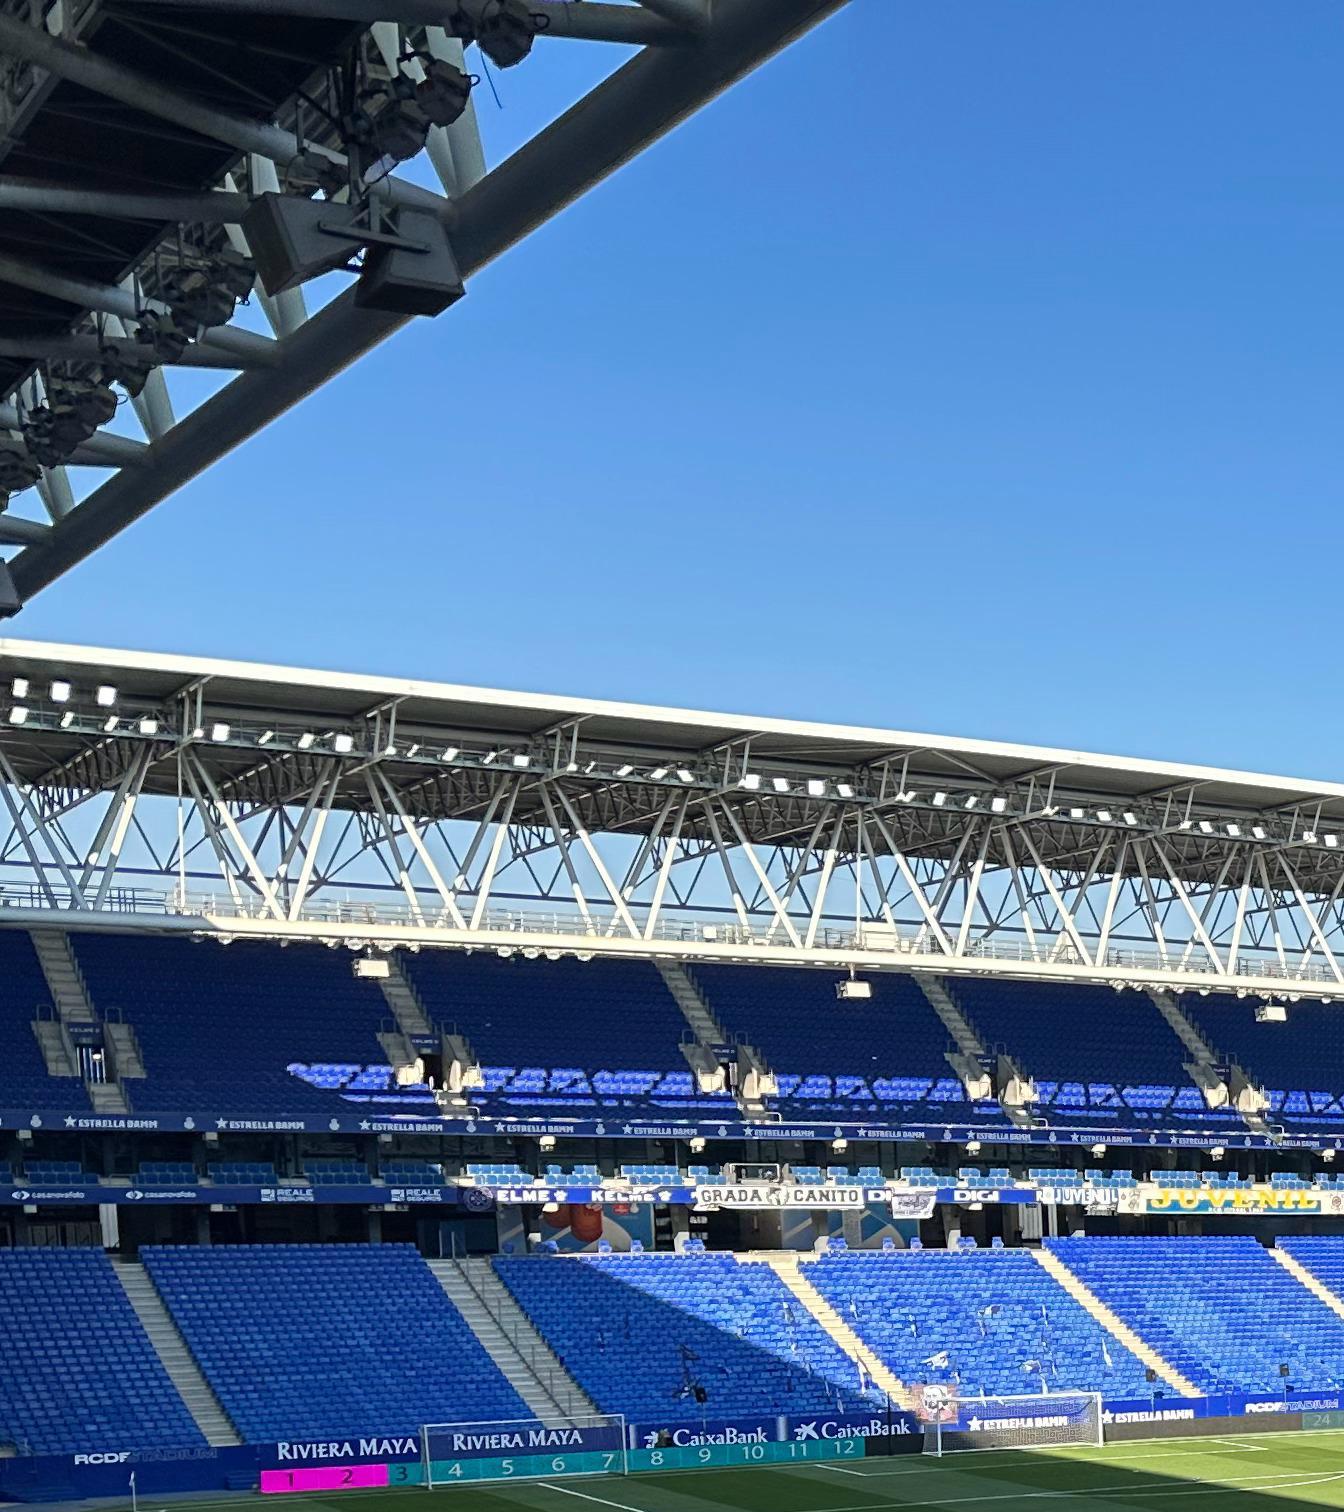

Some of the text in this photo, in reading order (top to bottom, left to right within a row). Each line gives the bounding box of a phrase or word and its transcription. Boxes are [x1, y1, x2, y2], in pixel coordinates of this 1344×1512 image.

[78, 1118, 158, 1129] ESTRELLA DAMM
[229, 1120, 305, 1130] ESTRELLA DAMM
[371, 1122, 443, 1132] ESTRELLA DAMM
[701, 1187, 859, 1203] GRADA CANITO
[953, 1190, 999, 1202] DIGI
[1055, 1188, 1119, 1204] JUVENIL
[1150, 1190, 1318, 1208] JUVENIL
[1115, 1408, 1194, 1424] ESTRELLA DAMM
[1313, 1413, 1330, 1426] 24
[821, 1418, 911, 1440] CaixaBank
[453, 1429, 583, 1452] RIVIERA MAYA
[673, 1427, 769, 1448] CaixaBank
[277, 1437, 418, 1461] RIVIERA MAYA
[286, 1440, 856, 1487] 1 2 3 4 5 6 7 8 9 10 11 12
